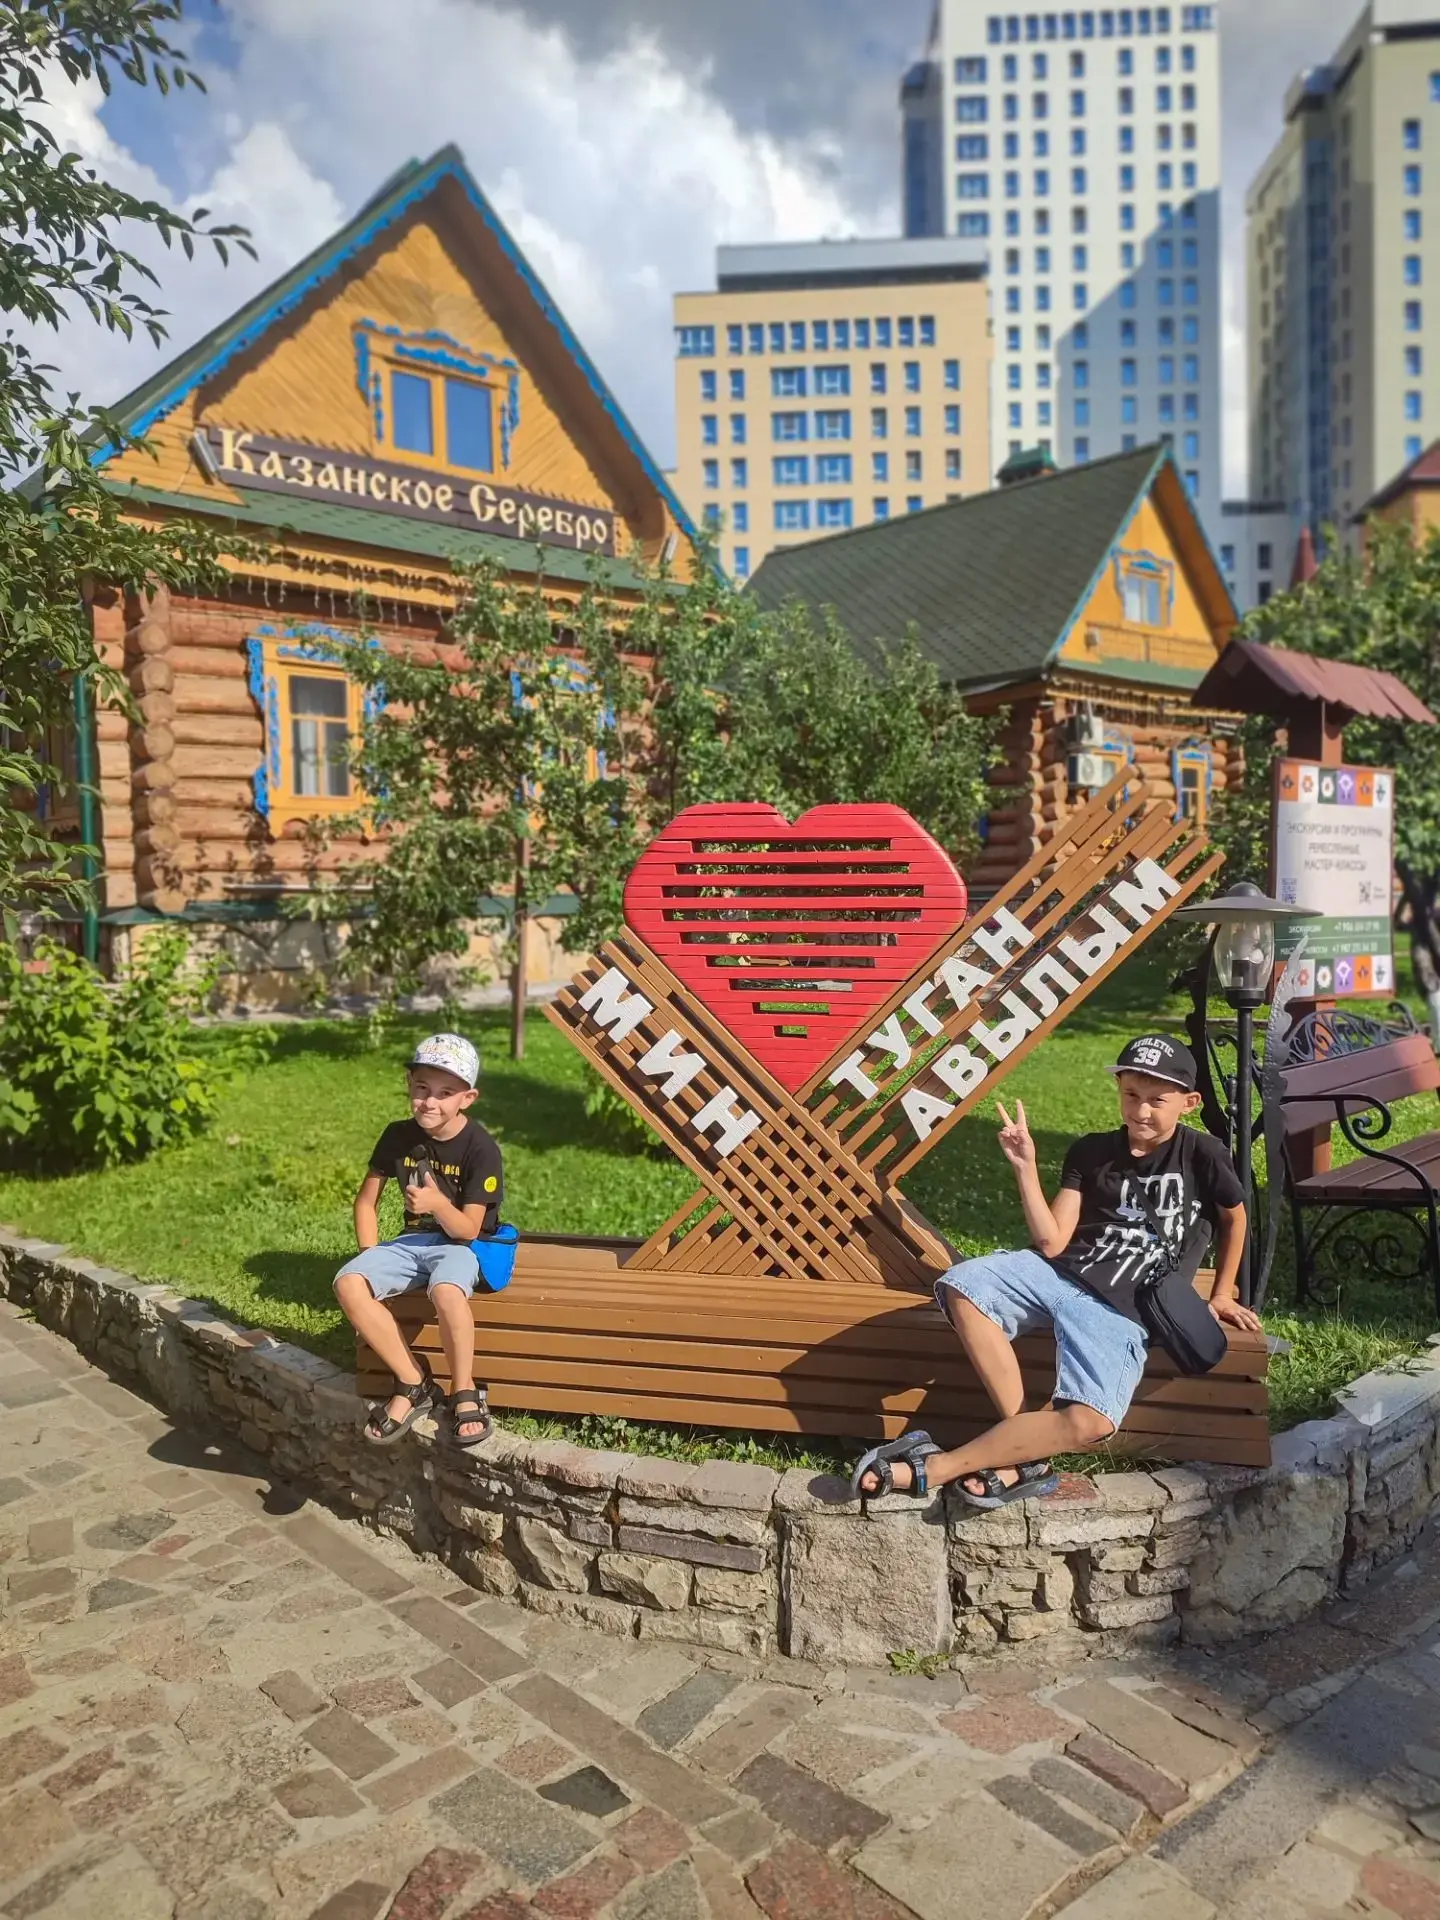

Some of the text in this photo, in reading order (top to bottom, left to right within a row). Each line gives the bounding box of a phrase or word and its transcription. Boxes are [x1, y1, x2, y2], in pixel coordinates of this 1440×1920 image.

[217, 428, 608, 550] Казанское Серебро
[577, 966, 762, 1158] МИН
[828, 905, 1036, 1100] ТУГАН
[900, 856, 1183, 1142] АВЫЛЫМ
[1130, 1037, 1175, 1058] ATHLETIC
[1133, 1046, 1162, 1067] 39
